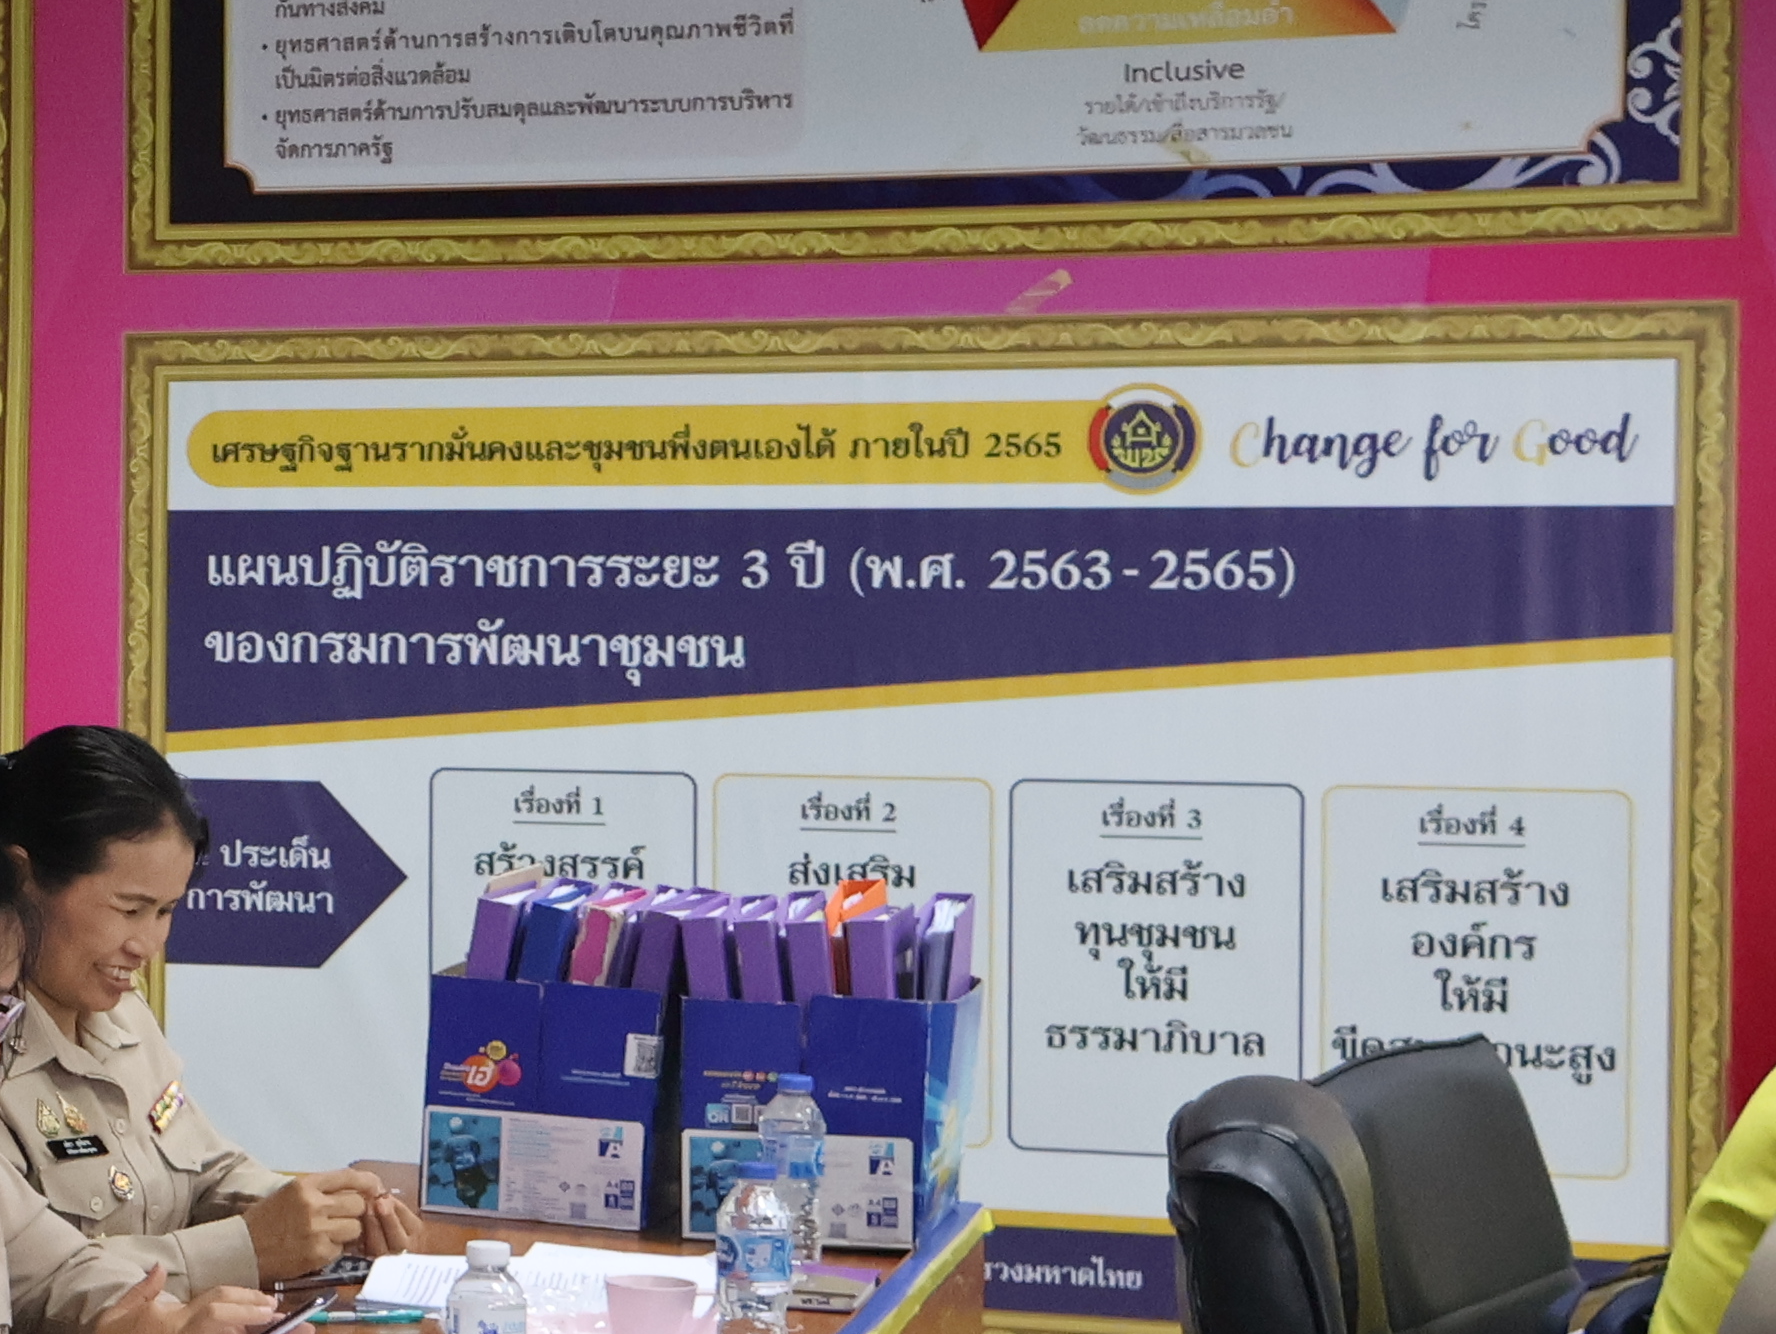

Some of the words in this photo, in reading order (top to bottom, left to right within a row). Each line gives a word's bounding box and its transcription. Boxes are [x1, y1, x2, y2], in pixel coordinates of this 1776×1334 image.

[1123, 59, 1246, 84] Inclusive
[211, 421, 838, 476] เศรษฐกิจฐานรากมั่นคงและชุมชนพึ่งตนเองได้
[849, 428, 970, 462] ภายในปี
[984, 429, 1062, 461] 2565
[1229, 415, 1414, 479] Change
[1423, 413, 1501, 482] for
[1512, 412, 1640, 467] Good
[206, 539, 721, 601] แผนปฏิบัติราชการระยะ
[741, 551, 771, 589] 3
[785, 539, 827, 591] ปี
[849, 546, 966, 596] (พ.ศ.
[205, 619, 745, 686] ของกรมการพัฒนาชุมชน
[512, 784, 582, 815] เรื่องที่
[592, 794, 605, 817] 1
[799, 793, 875, 824] เรื่องที่
[883, 802, 897, 822] 2
[1100, 797, 1178, 830] เรื่องที่
[1186, 808, 1203, 829] 3
[1418, 805, 1500, 838] เรื่องที่
[1508, 814, 1526, 838] 4
[219, 837, 332, 874] ประเด็น
[787, 856, 916, 890] ส่งเสริม
[186, 883, 335, 915] การพัฒนา
[1066, 860, 1247, 899] เสริมสร้าง
[1380, 870, 1570, 908] เสริมสร้าง
[1074, 917, 1236, 961] ทุนชุมชน
[1410, 921, 1537, 961] องค์กร
[1122, 959, 1190, 1002] ให้มี
[1433, 970, 1509, 1014] ให้มี
[1045, 1017, 1267, 1058] ธรรมาภิบาล
